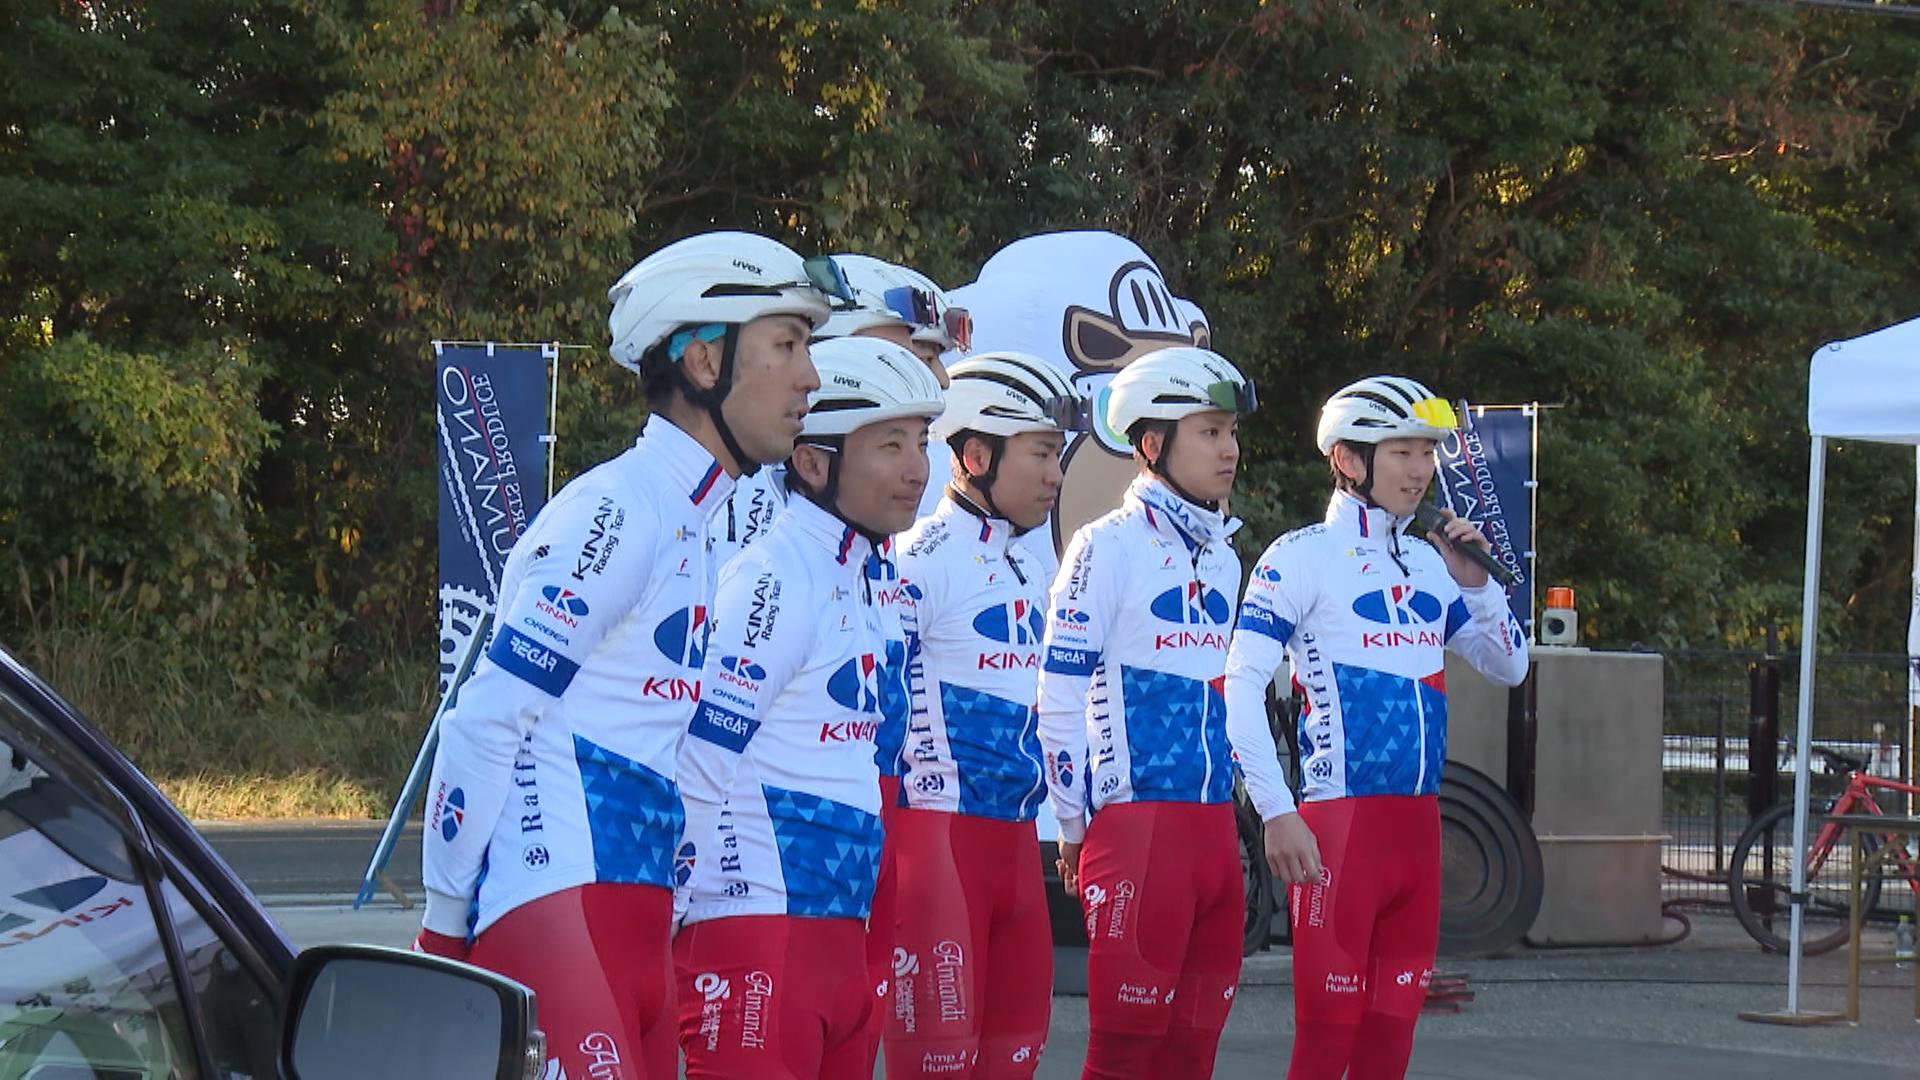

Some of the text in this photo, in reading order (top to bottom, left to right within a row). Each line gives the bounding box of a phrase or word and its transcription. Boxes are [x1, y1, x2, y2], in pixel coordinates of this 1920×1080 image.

[732, 259, 763, 276] uvex
[833, 375, 862, 390] uvex
[572, 496, 615, 581] KINAN
[593, 536, 620, 576] Racing
[743, 512, 773, 649] KINAN
[535, 600, 578, 629] KINAN
[761, 603, 780, 641] Racing
[1155, 631, 1229, 651] KINAN
[1362, 630, 1444, 649] KINAN
[643, 677, 701, 703] KIN
[718, 671, 760, 693] KINAN
[1326, 972, 1351, 984] Amp
[1117, 991, 1157, 1005] Human
[1120, 982, 1147, 995] Amp
[922, 1052, 955, 1064] Amp
[922, 1062, 965, 1073] Human
